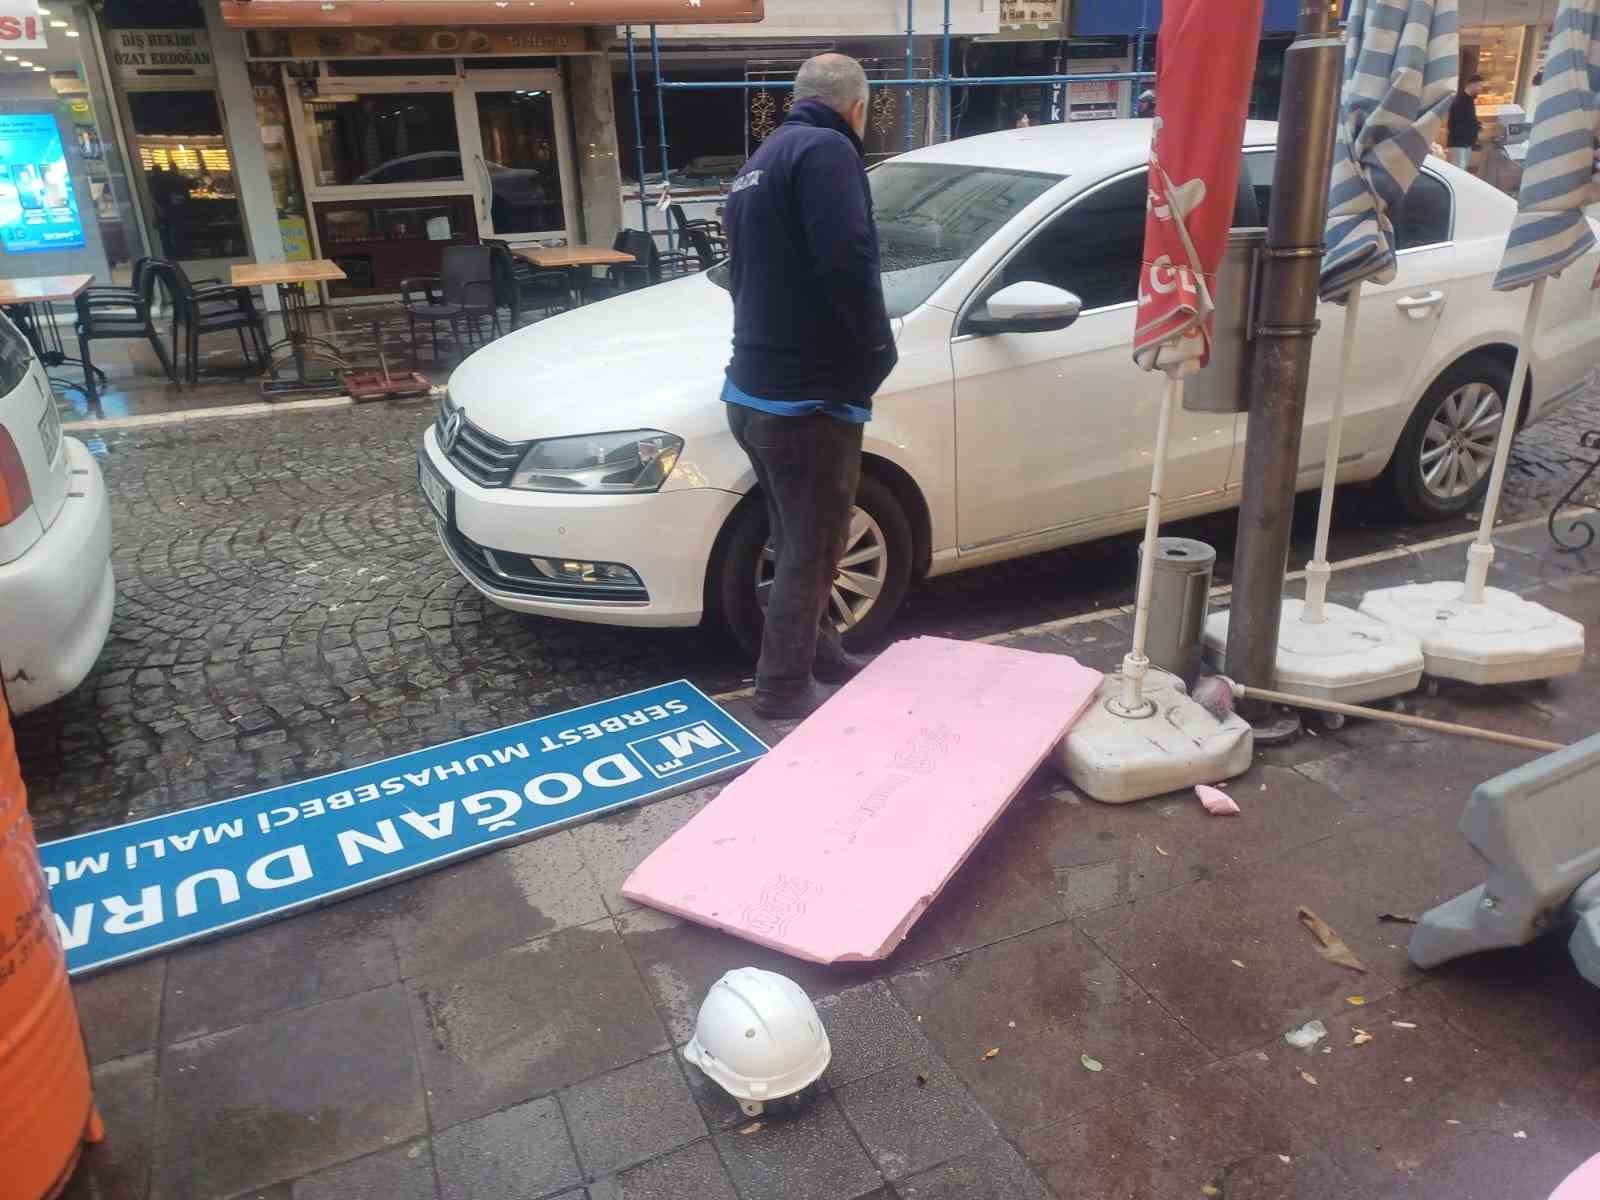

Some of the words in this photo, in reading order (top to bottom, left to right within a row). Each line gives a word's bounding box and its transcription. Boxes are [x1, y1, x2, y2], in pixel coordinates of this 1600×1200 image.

[541, 699, 688, 753] SERBEST
[257, 742, 530, 834] MUHASEBECİ
[337, 752, 645, 866] DOĞAN
[125, 818, 244, 869] MALİ
